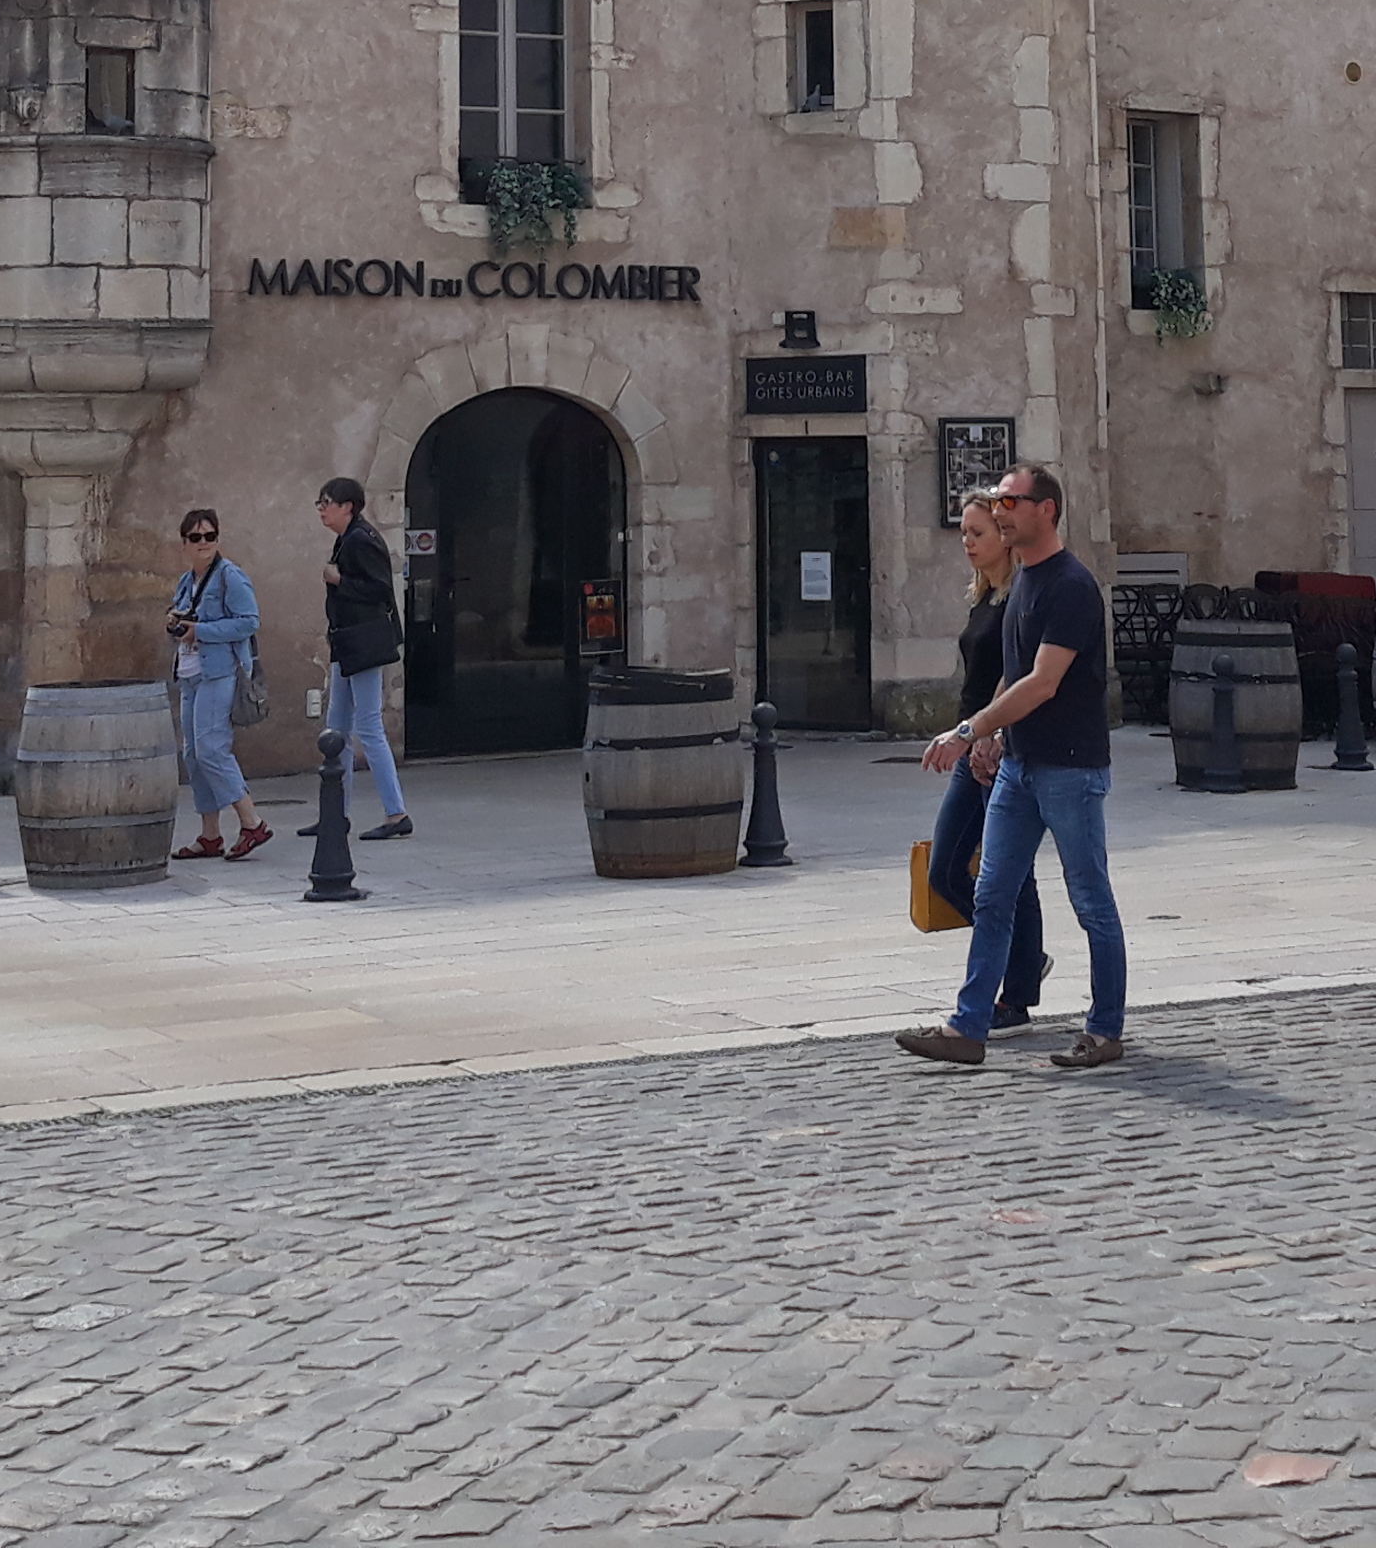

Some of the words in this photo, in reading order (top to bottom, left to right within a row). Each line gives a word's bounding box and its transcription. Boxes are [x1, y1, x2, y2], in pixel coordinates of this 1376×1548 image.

[248, 257, 424, 297] MAISON
[430, 278, 462, 298] DU
[467, 260, 702, 302] COLOMBIER
[755, 387, 793, 400] GITES
[797, 385, 855, 399] URBAINS
